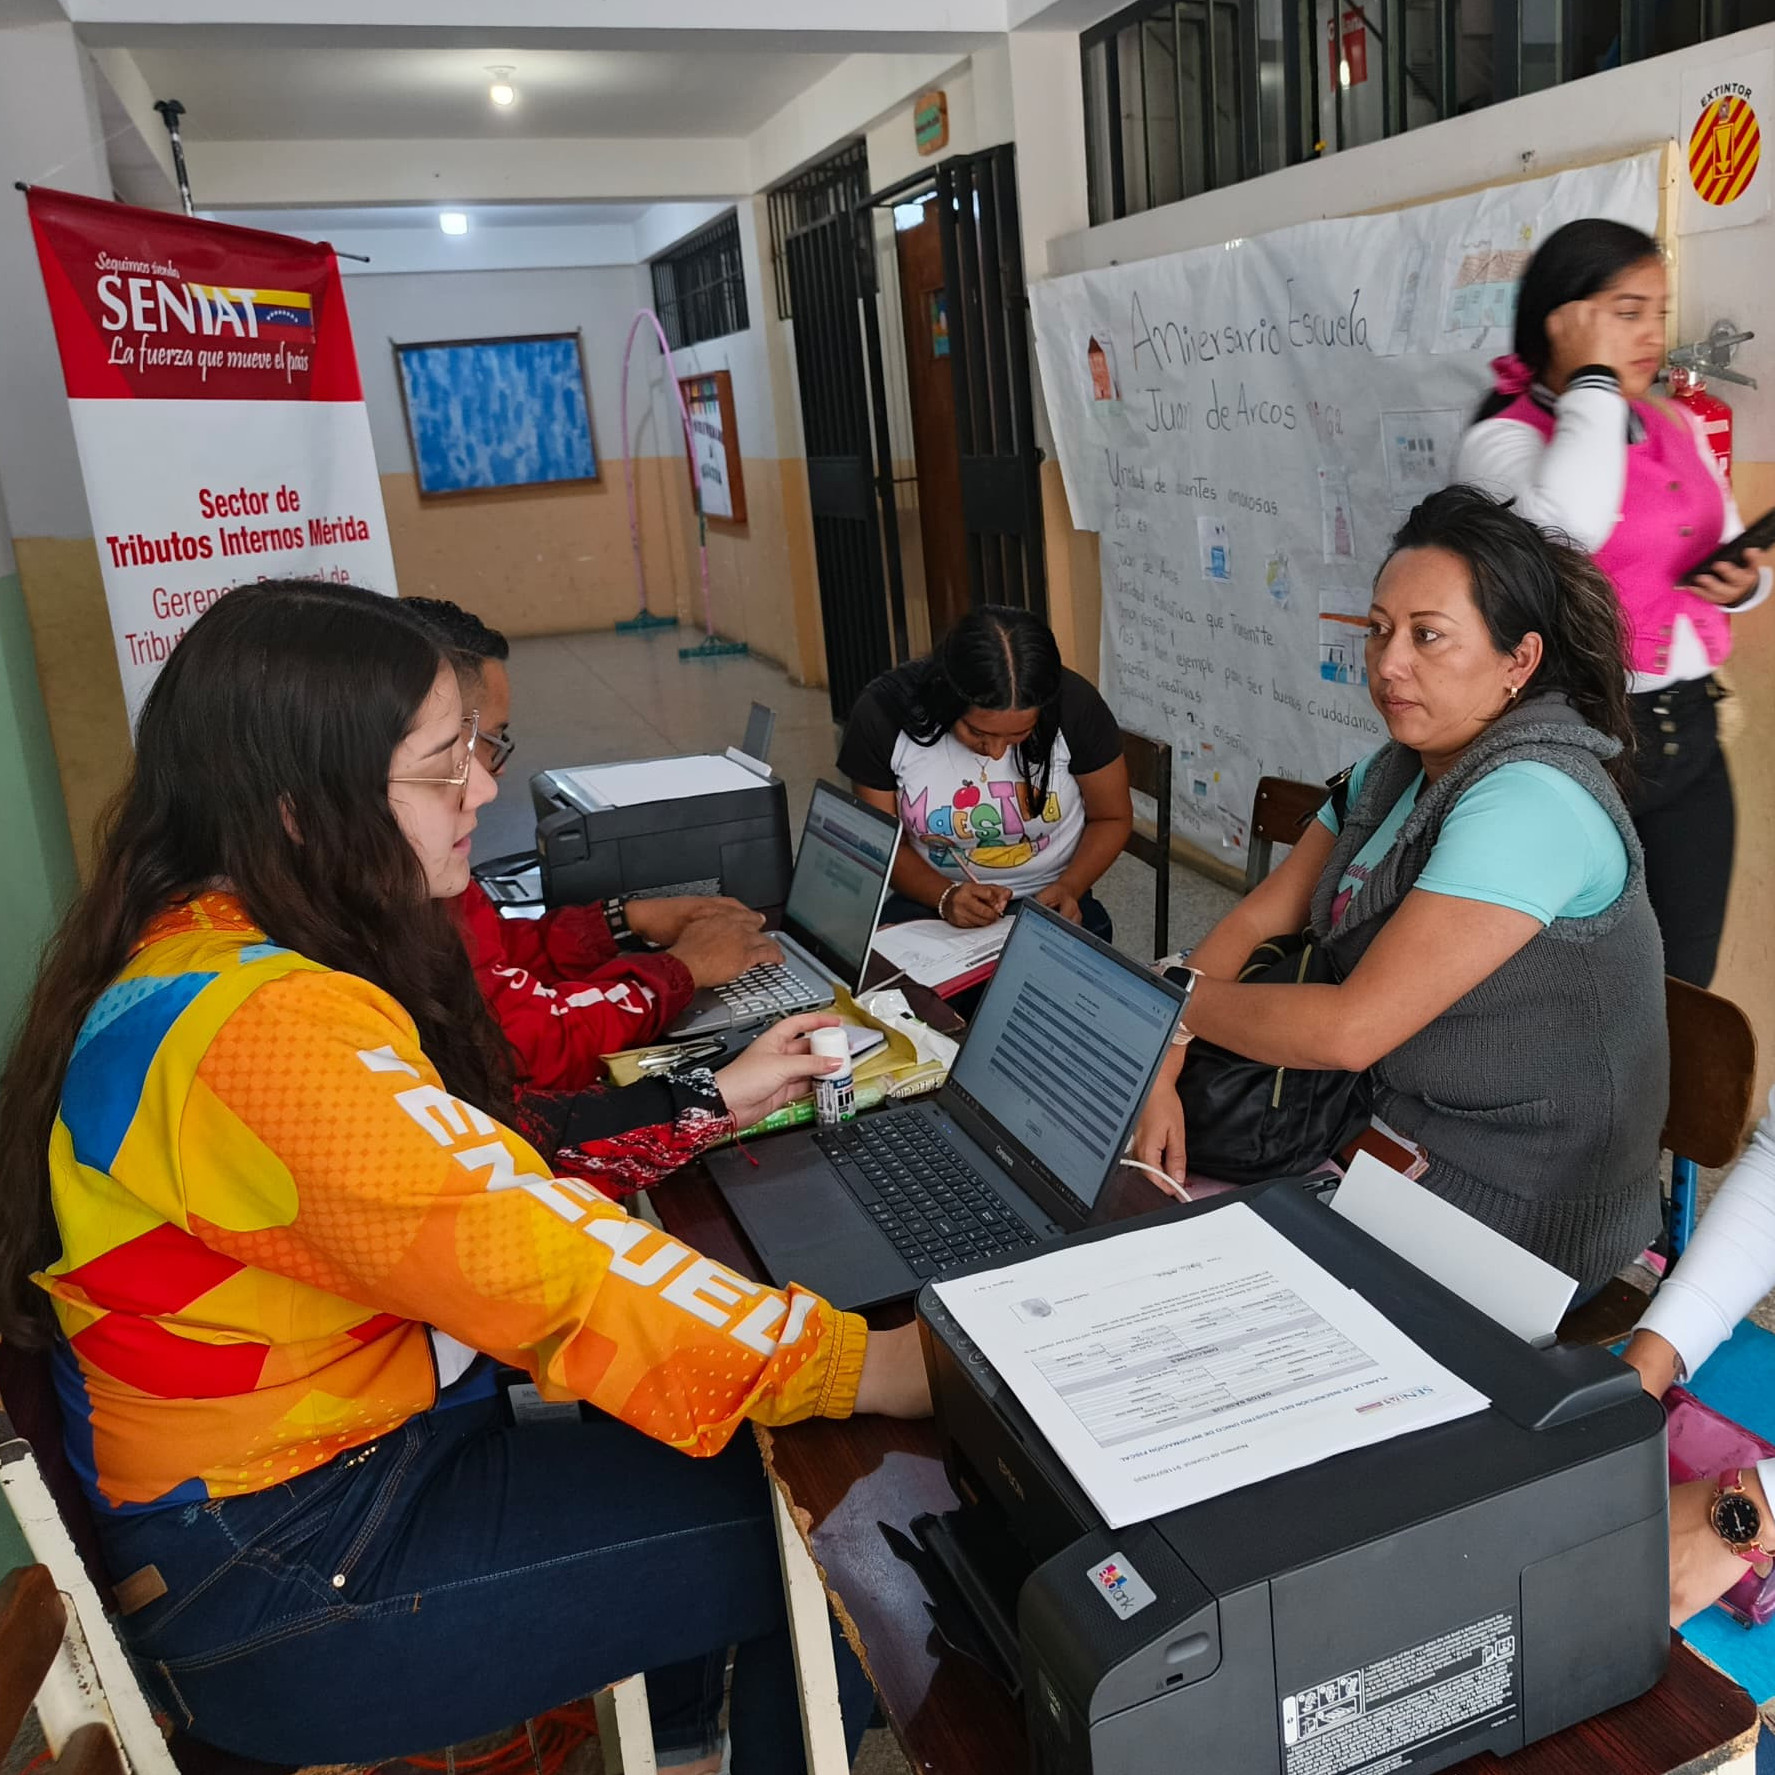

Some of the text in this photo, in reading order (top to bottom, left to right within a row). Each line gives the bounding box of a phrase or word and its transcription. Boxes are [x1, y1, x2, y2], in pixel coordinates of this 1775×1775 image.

[1700, 82, 1752, 107] EXTINTOR
[95, 251, 150, 277] Seguimos
[97, 274, 259, 338] SENIAT
[1287, 278, 1373, 352] Escuela
[108, 336, 134, 365] La
[139, 333, 193, 373] fuerza
[198, 350, 223, 382] que
[227, 350, 272, 369] mueve
[274, 341, 285, 369] el
[1206, 379, 1231, 431] de
[1237, 382, 1296, 430] Arcos
[199, 484, 300, 519] Sector de
[106, 515, 370, 568] Tributos Internos Mérida
